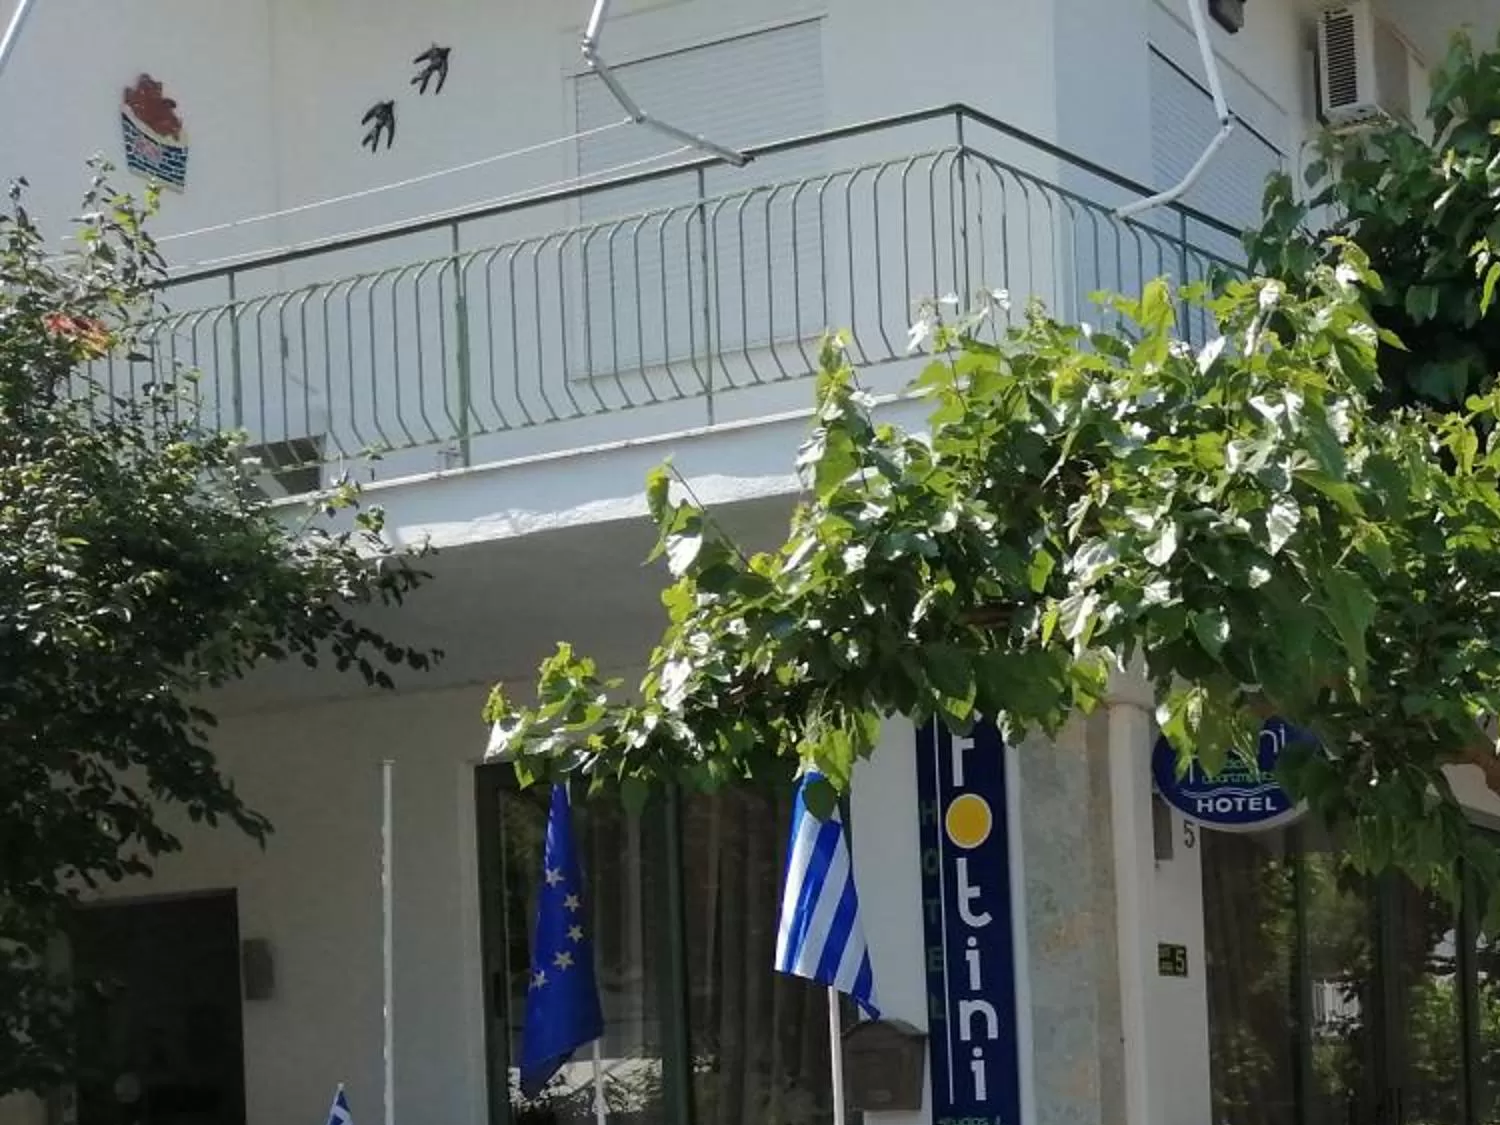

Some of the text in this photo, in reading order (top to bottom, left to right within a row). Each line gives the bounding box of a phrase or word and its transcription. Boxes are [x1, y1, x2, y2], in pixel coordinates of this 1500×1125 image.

[1197, 797, 1277, 813] HOTEL
[1183, 820, 1196, 848] 5
[1175, 949, 1185, 973] 5
